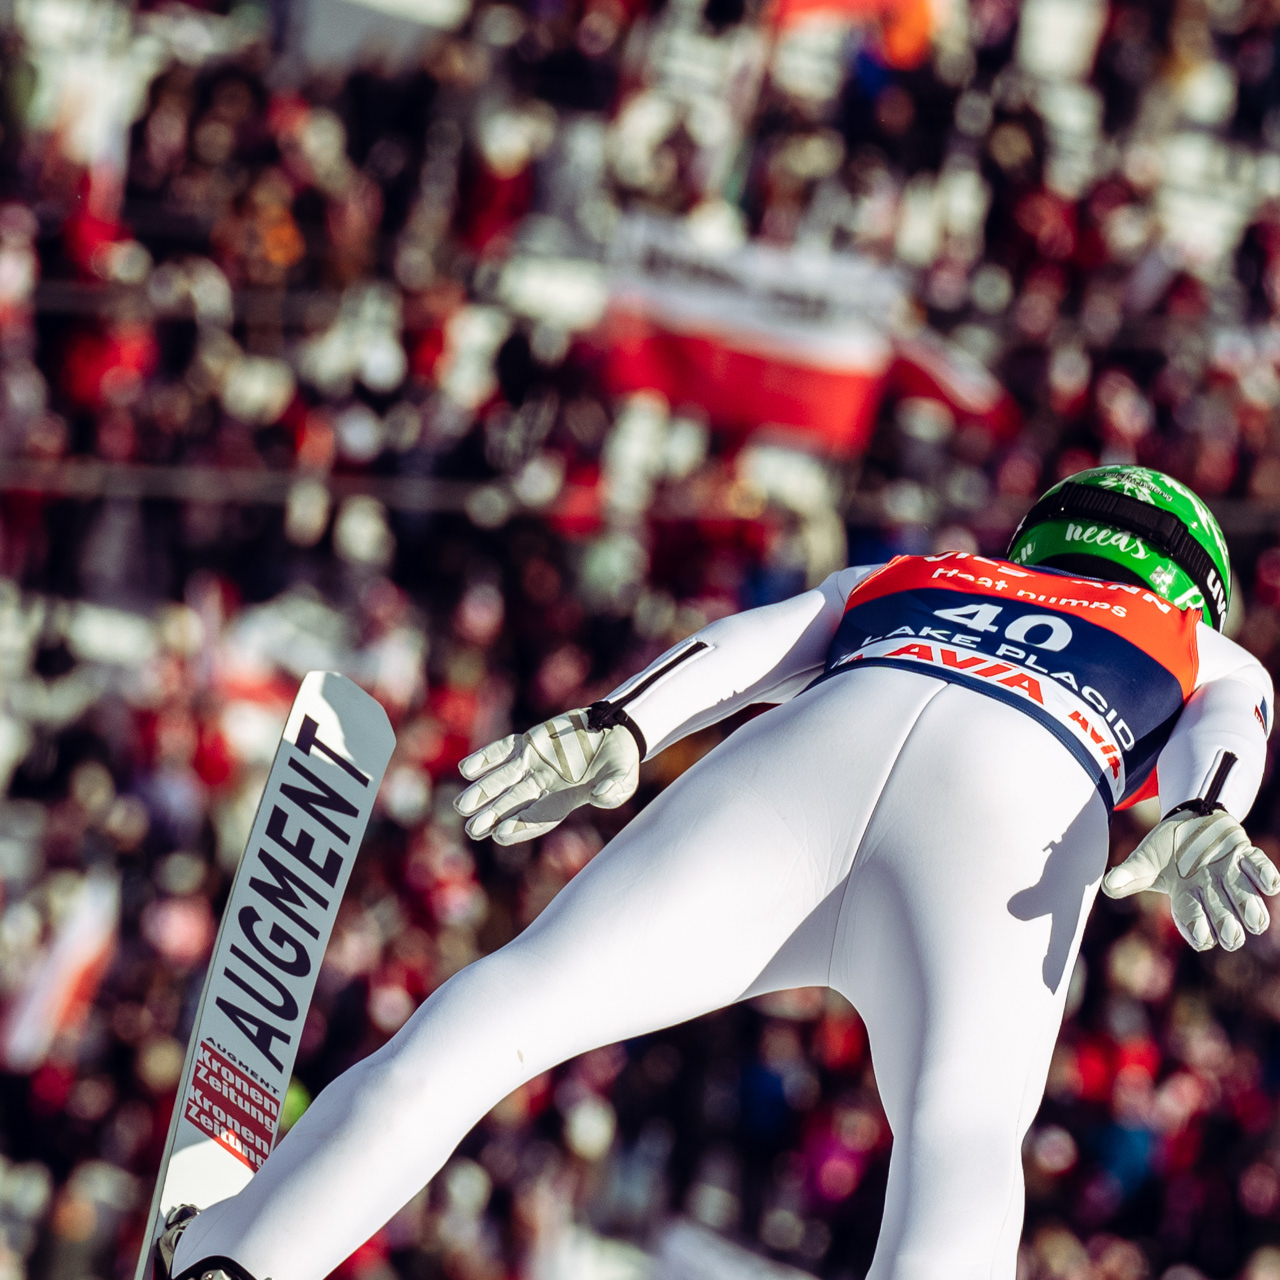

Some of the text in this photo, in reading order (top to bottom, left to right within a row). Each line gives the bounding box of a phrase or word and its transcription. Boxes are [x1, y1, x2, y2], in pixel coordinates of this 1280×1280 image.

[932, 603, 1073, 652] 40
[861, 626, 1135, 751] LAKE PLACID
[215, 714, 373, 1074] AUGMENT
[196, 1062, 277, 1134] Zeitung
[197, 1045, 278, 1116] Kronen
[206, 1036, 280, 1095] AUGMENT
[187, 1100, 267, 1169] Zeitung
[188, 1084, 270, 1155] Kronen
